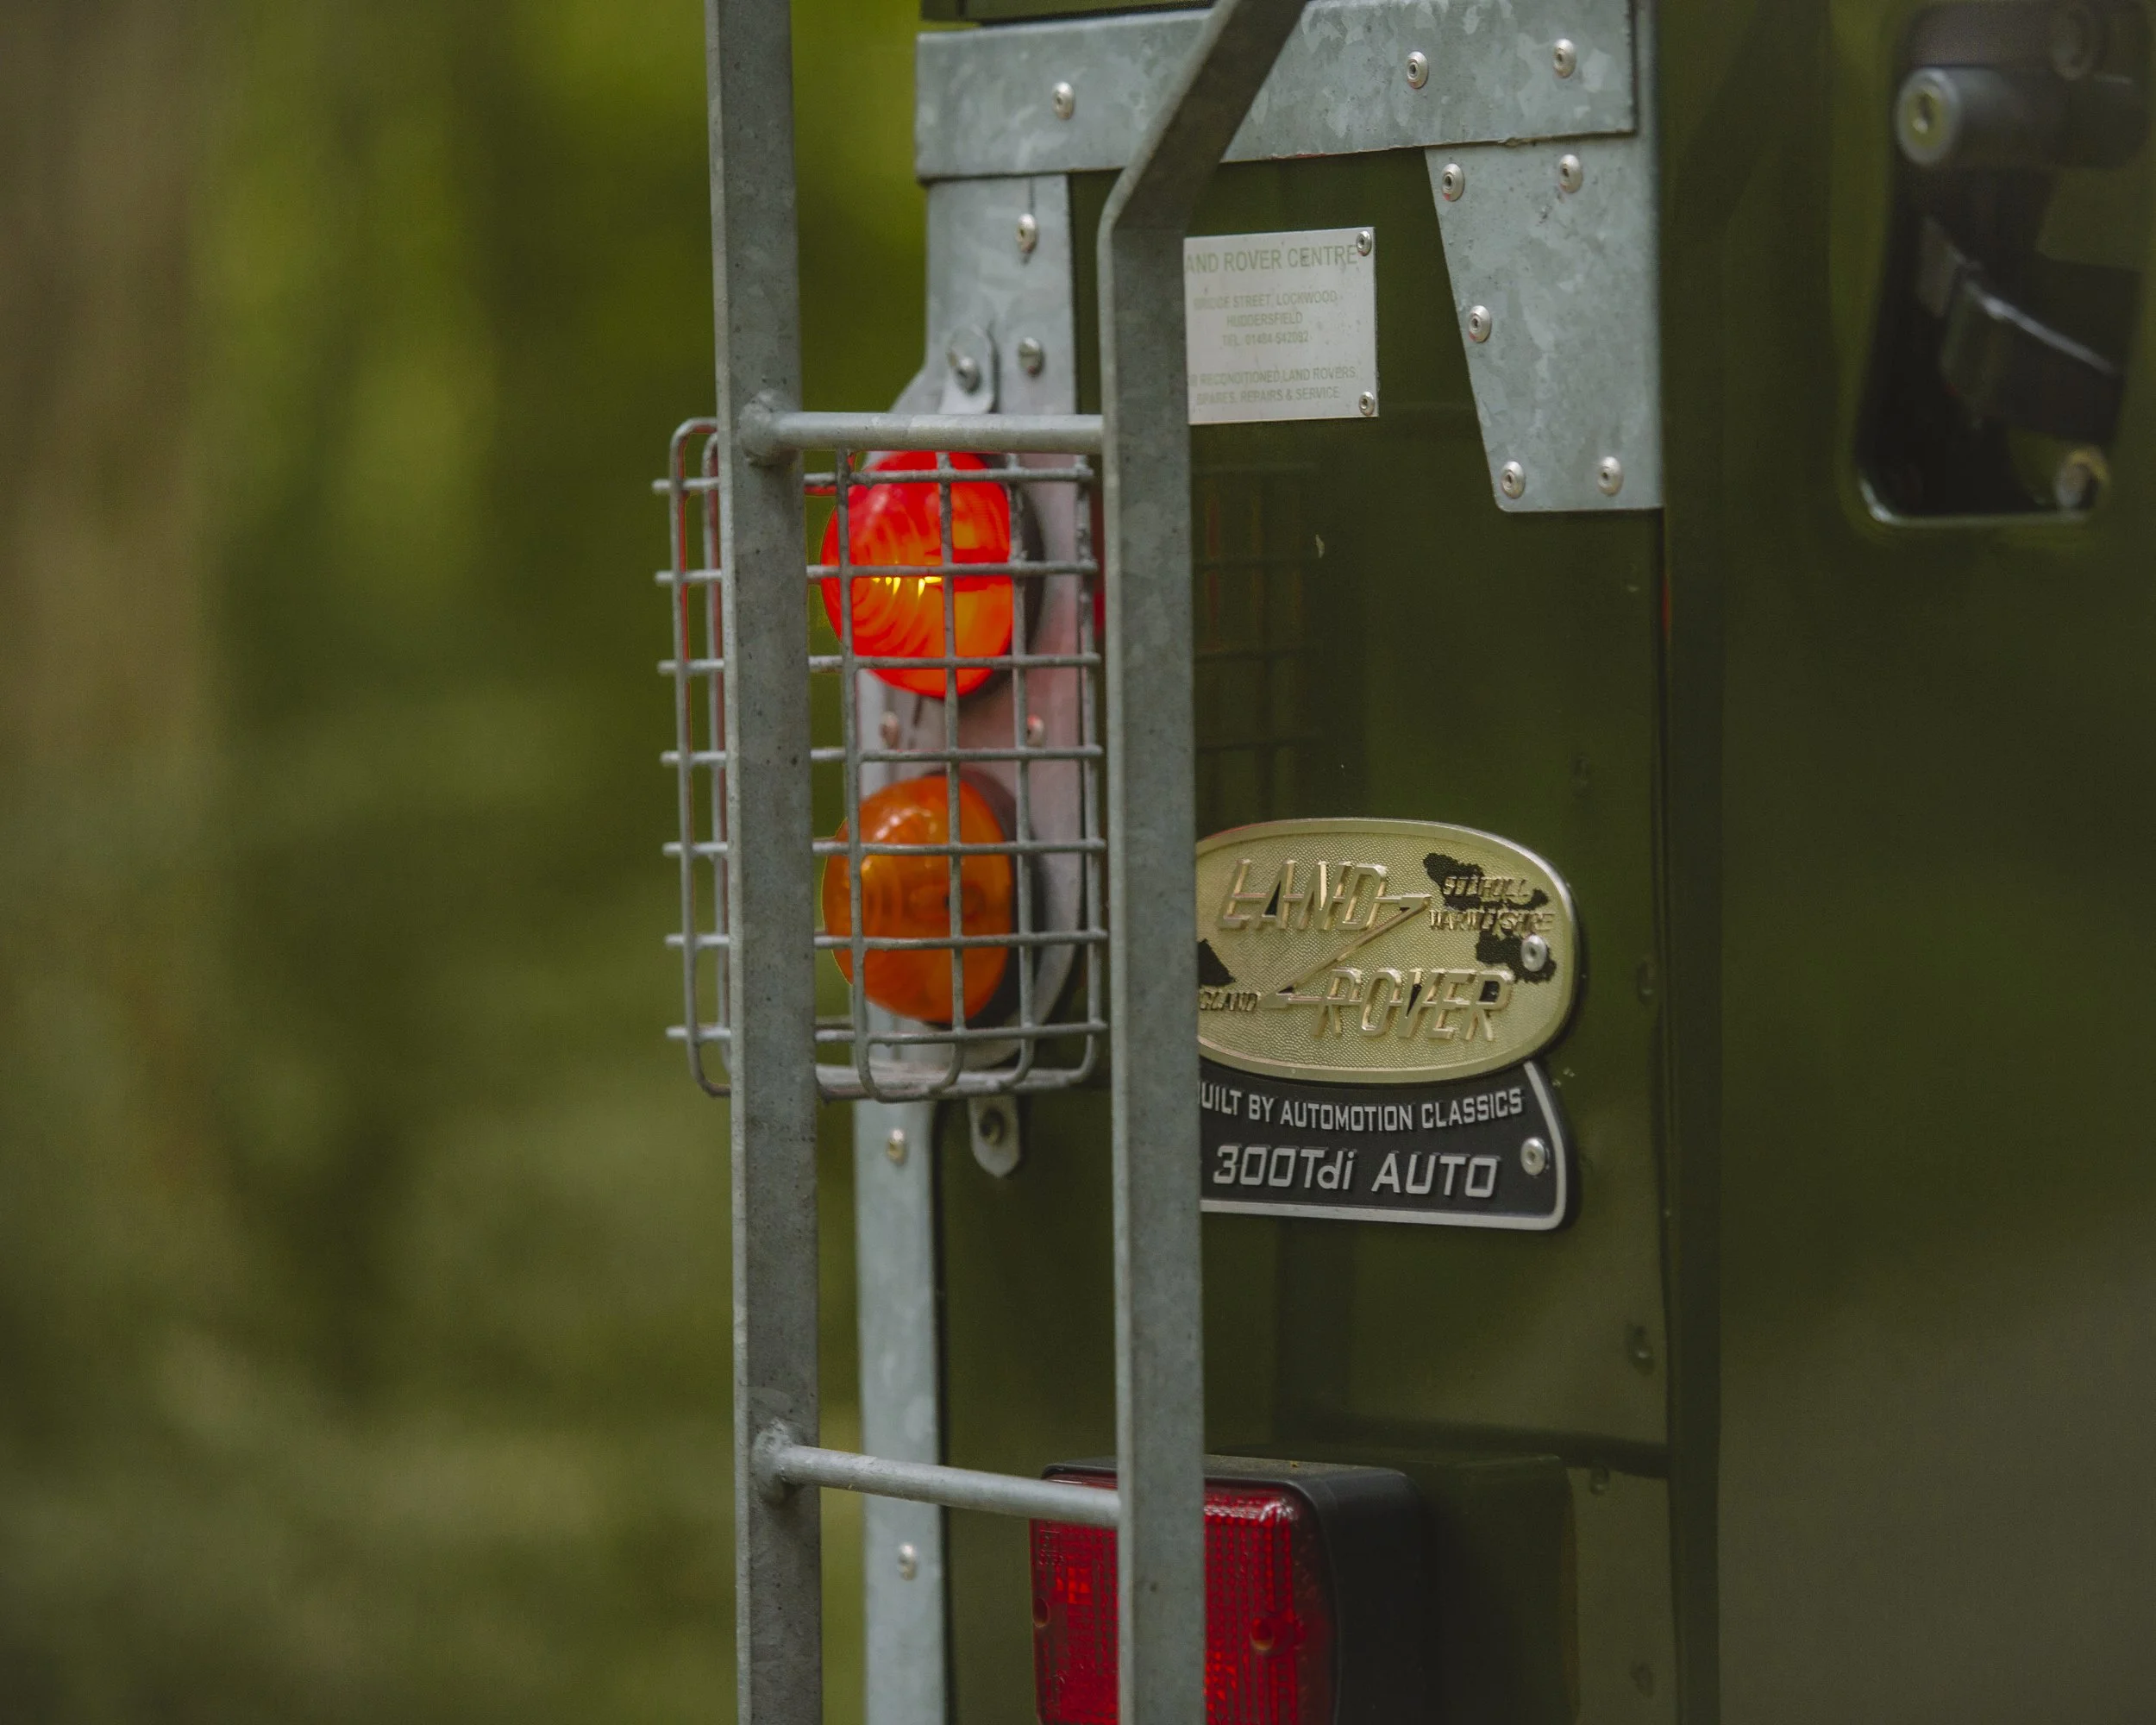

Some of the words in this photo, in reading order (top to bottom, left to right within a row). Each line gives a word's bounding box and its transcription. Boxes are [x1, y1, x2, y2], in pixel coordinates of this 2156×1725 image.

[1185, 252, 1219, 273] AND
[1224, 248, 1282, 273] ROVER
[1288, 243, 1357, 267] CENTRE
[1282, 367, 1310, 382] LAND
[1286, 388, 1294, 402] &
[1295, 386, 1339, 401] SERVICE
[1215, 859, 1388, 932] LAND
[1199, 989, 1260, 1013] GLAND
[1309, 966, 1514, 1041] ROVER
[1198, 1080, 1243, 1116] UILT
[1249, 1093, 1275, 1123] BY
[1280, 1100, 1413, 1132] AUTOMOTION
[1421, 1087, 1523, 1129] CLASSICS
[1213, 1144, 1357, 1190] 300Tdi
[1370, 1151, 1499, 1198] AUTO
